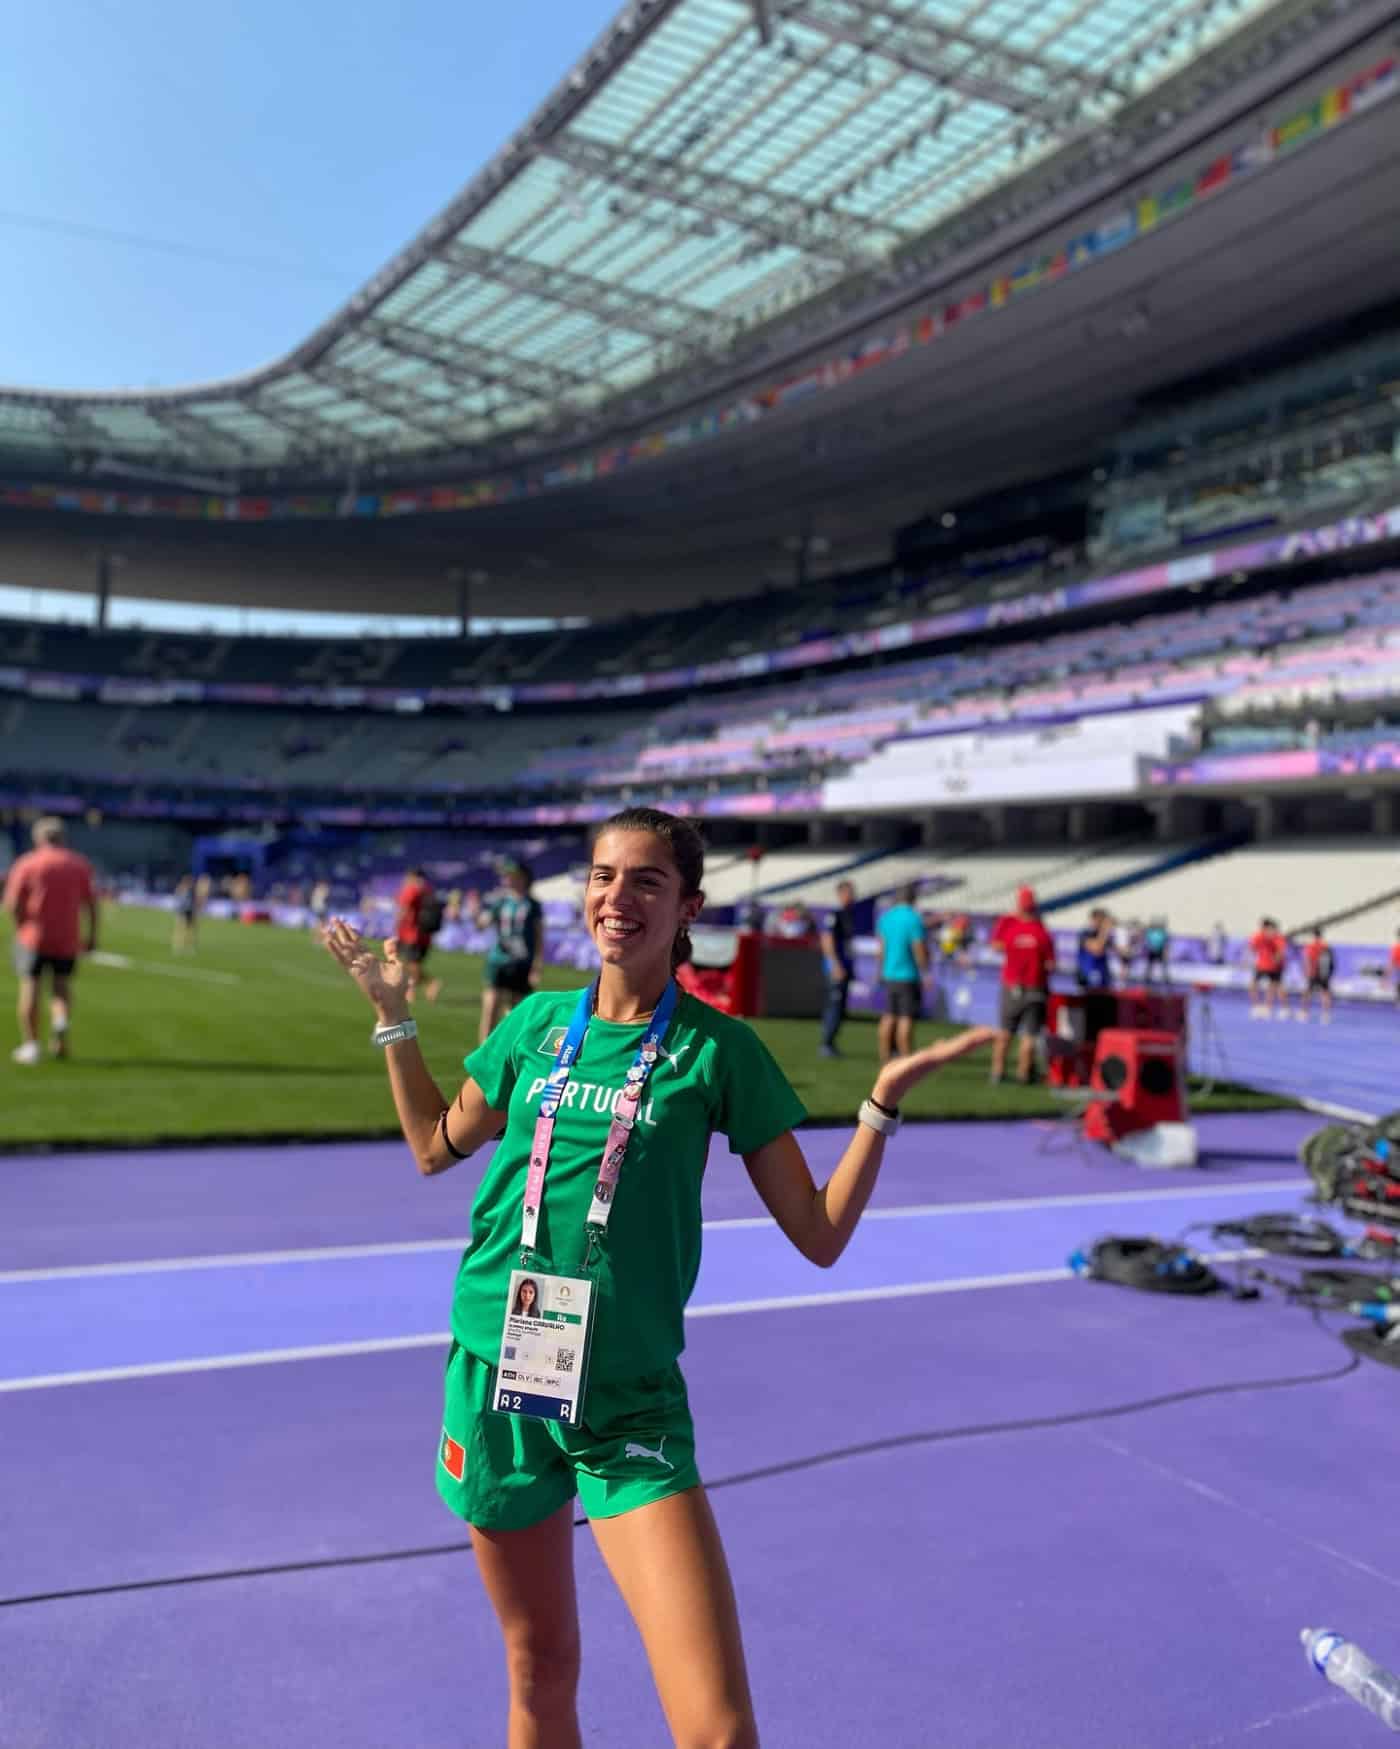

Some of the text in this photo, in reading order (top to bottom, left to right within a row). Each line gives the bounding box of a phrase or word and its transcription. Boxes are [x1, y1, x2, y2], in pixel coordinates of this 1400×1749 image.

[525, 1078, 657, 1126] PRTUL
[512, 1395, 522, 1410] 2
[560, 1403, 570, 1418] R
